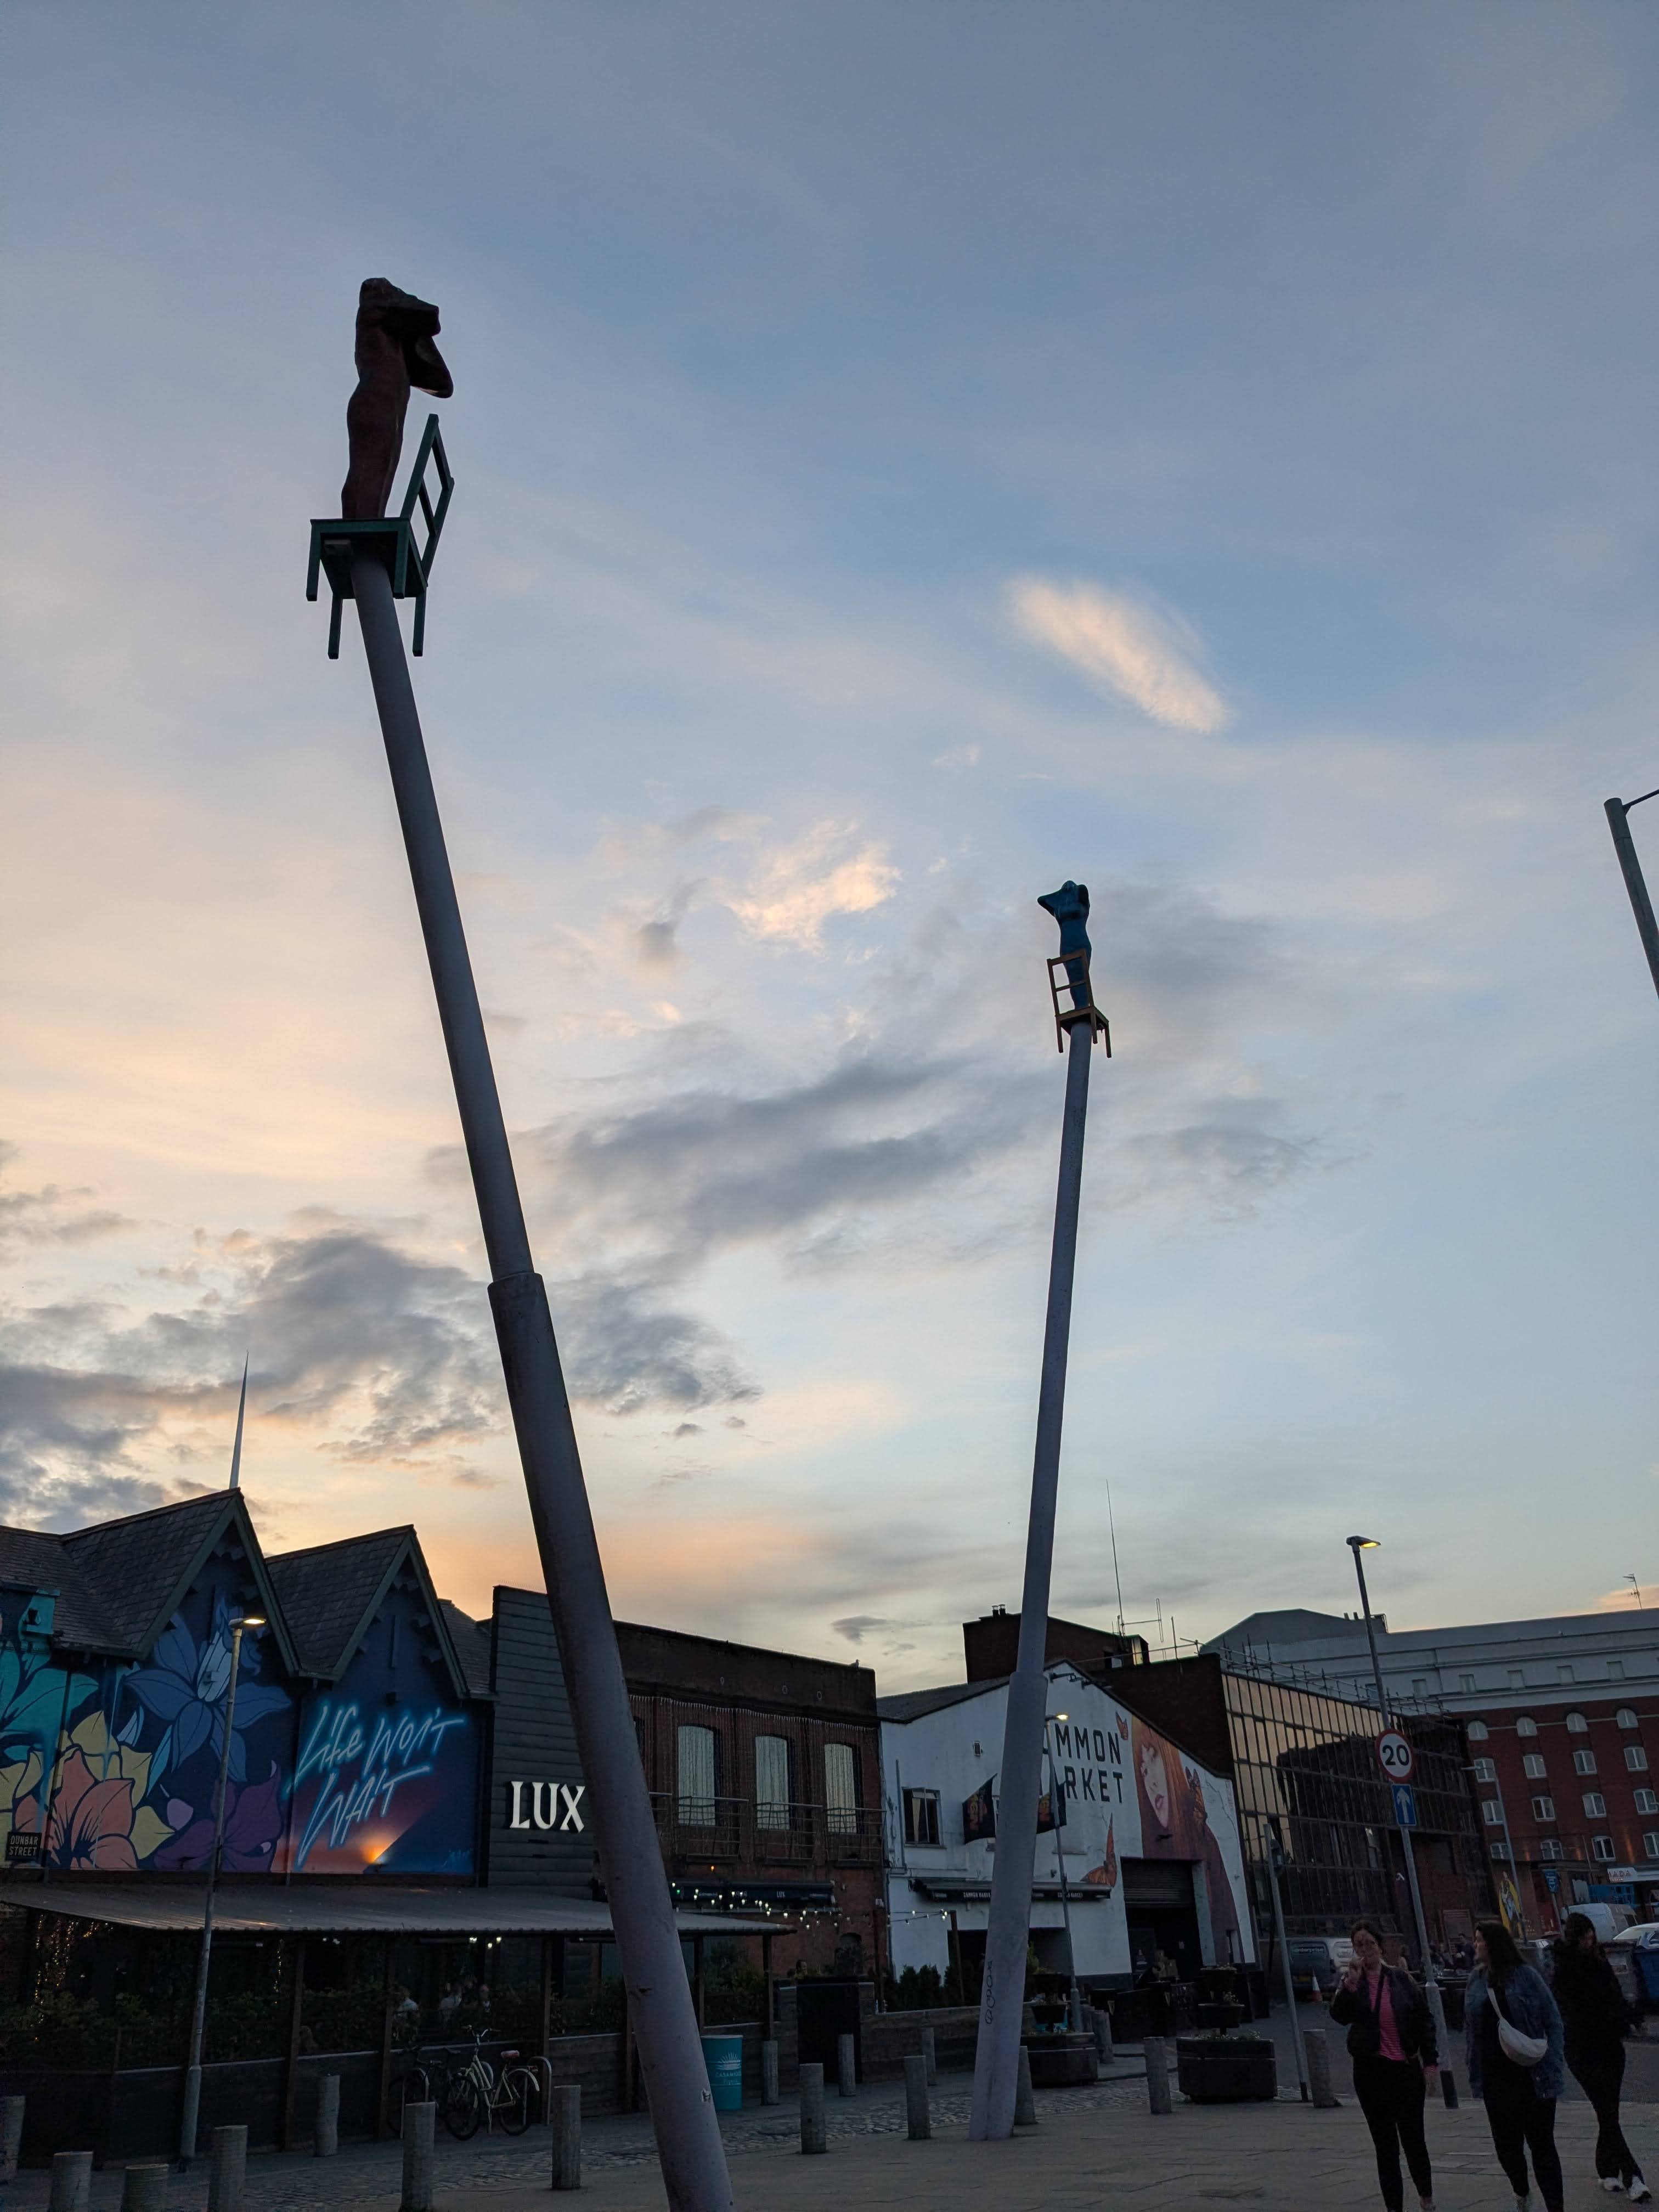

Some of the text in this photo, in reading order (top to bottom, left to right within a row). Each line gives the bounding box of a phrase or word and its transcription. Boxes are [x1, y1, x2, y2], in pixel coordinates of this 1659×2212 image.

[1043, 1723, 1121, 1764] MMON
[1383, 1745, 1409, 1765] 20
[1053, 1765, 1122, 1804] RKET
[510, 1781, 586, 1833] LUX
[9, 1846, 37, 1857] STREET
[10, 1835, 38, 1845] DUNBAR
